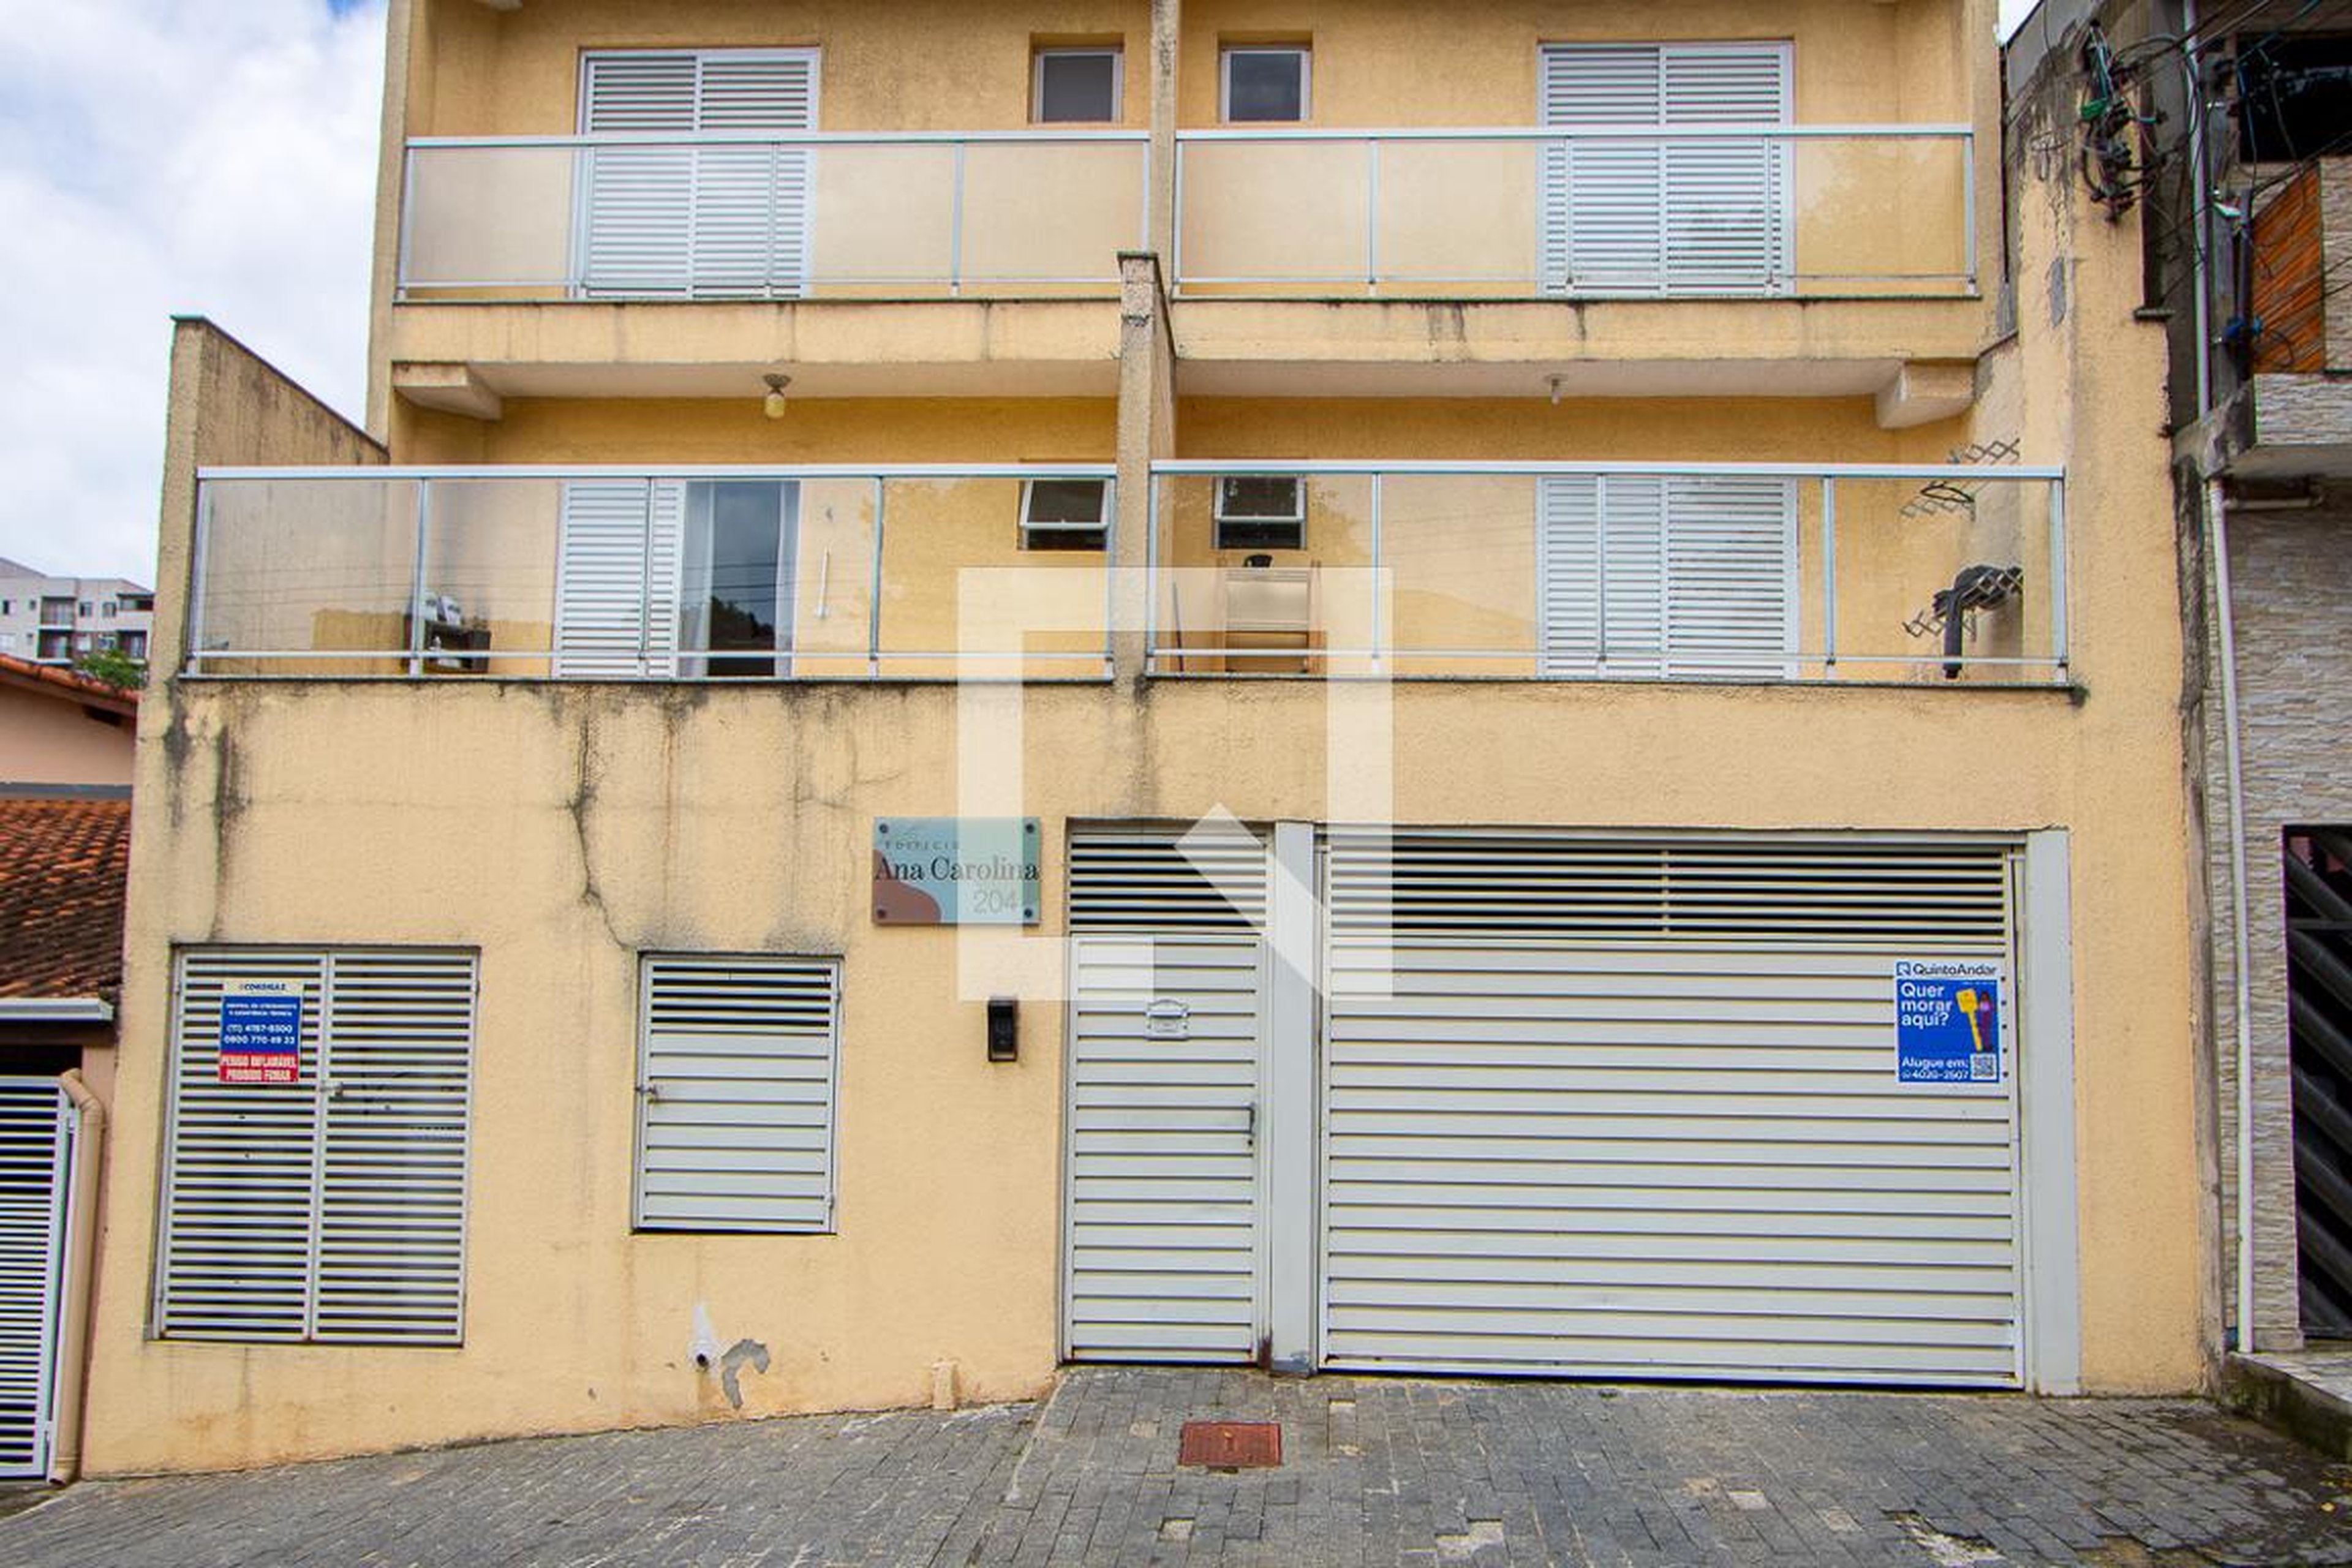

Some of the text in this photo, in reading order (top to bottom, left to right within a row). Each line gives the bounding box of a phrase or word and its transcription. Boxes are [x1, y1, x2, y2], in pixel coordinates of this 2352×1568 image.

[875, 854, 1039, 881] Ana Carolina
[973, 891, 1018, 913] 204
[1912, 963, 1997, 975] QuintoAndar
[1901, 982, 1944, 998] Quer
[1901, 1000, 1952, 1011] morar
[1901, 1012, 1949, 1029] aqui?
[1901, 1055, 1944, 1069] Alugue
